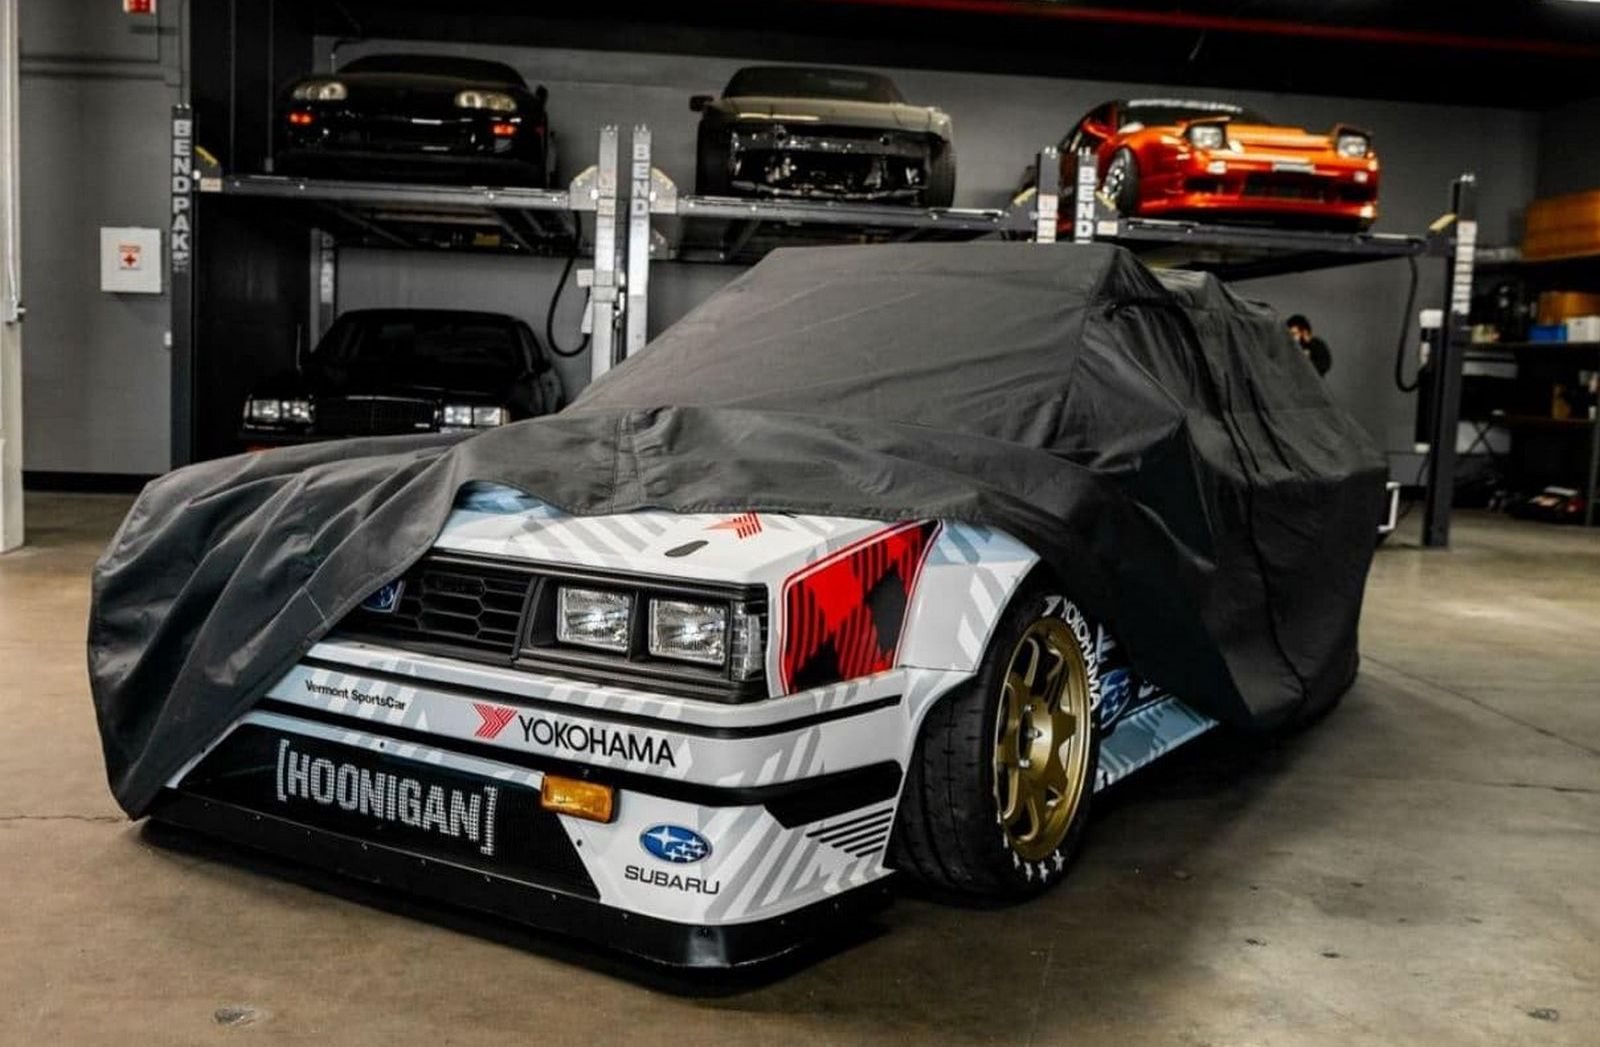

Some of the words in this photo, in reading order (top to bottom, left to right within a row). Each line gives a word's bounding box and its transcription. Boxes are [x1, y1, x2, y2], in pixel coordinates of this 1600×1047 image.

[173, 120, 191, 250] BENDPAK
[632, 144, 650, 232] BEND
[1075, 166, 1096, 243] BEND
[1061, 597, 1101, 712] YOKOHAMA
[305, 680, 348, 698] Vermont
[351, 690, 406, 710] SportsCar
[519, 715, 675, 767] YOKOHAMA
[624, 865, 719, 895] SUBARU
